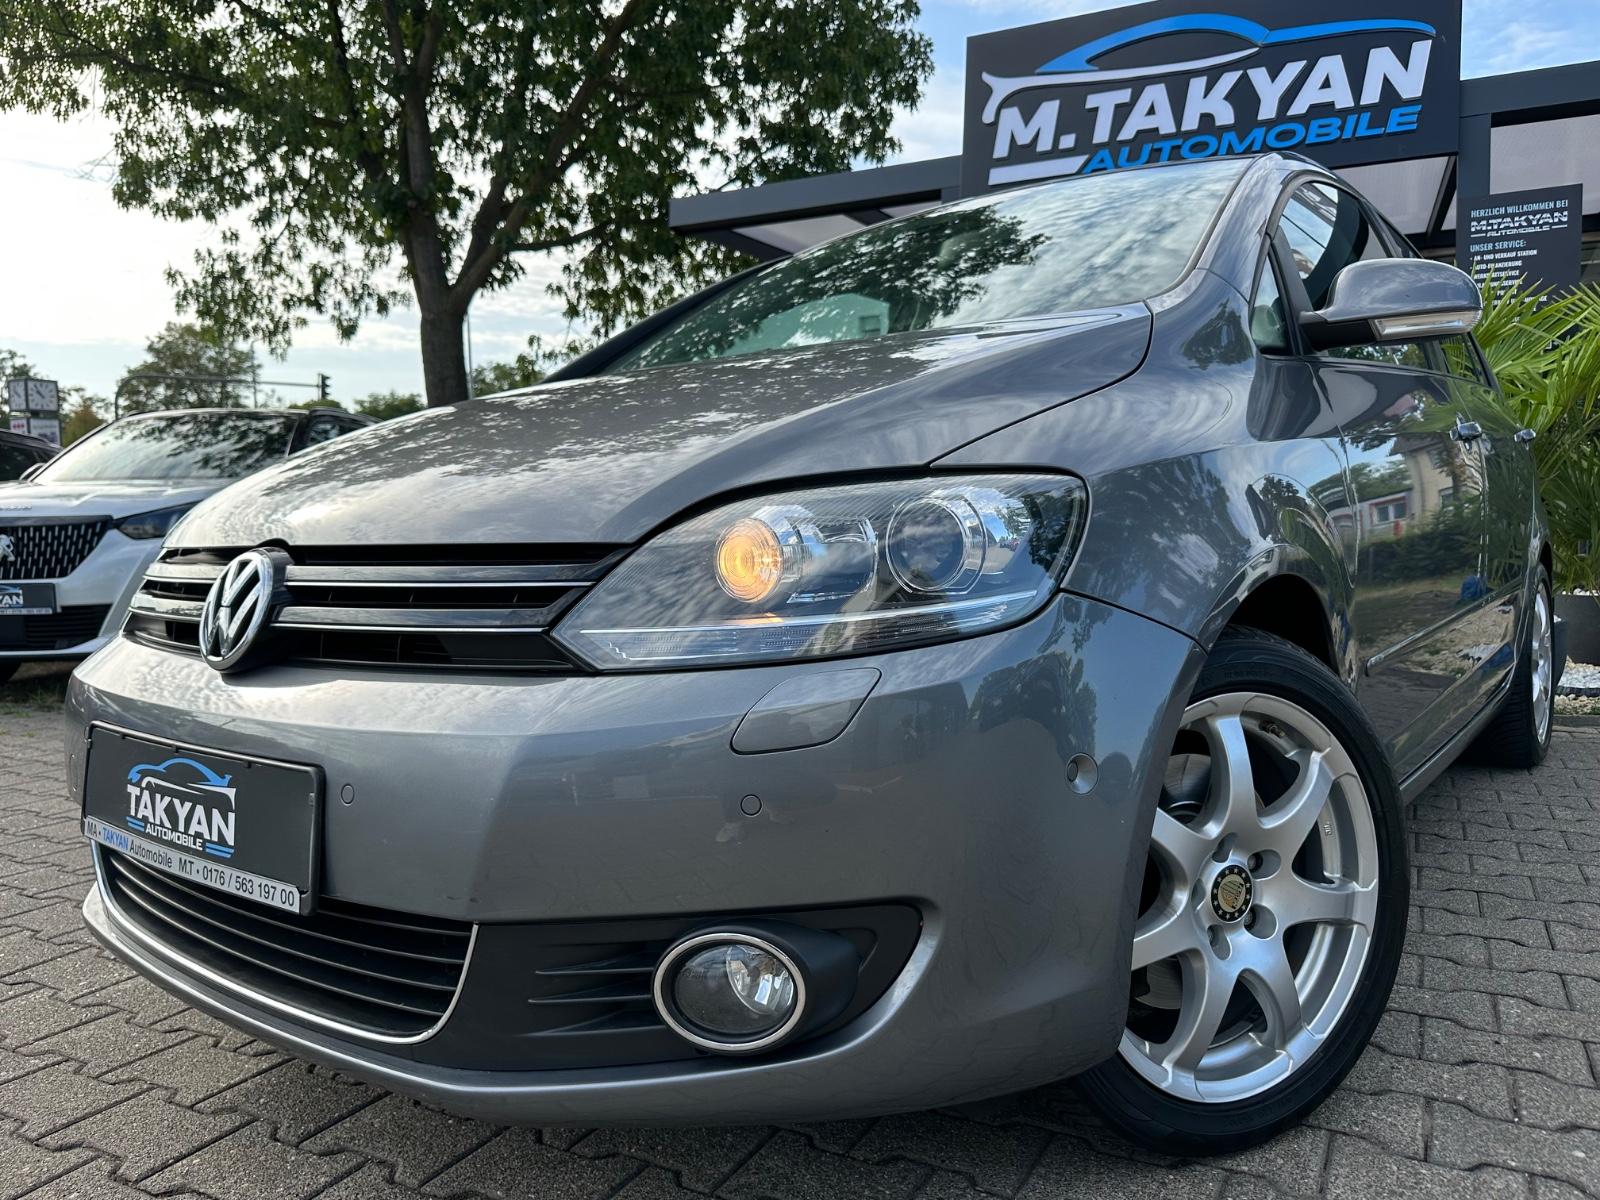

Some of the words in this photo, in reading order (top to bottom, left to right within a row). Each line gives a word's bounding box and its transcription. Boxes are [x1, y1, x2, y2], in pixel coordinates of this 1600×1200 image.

[1083, 104, 1423, 174] AUTOMOBILE
[1471, 206, 1505, 218] HERZLICH
[1506, 201, 1555, 214] WILLKOMMEN
[1556, 199, 1568, 208] BEI
[1470, 210, 1568, 232] M.TAKYAN
[1487, 225, 1550, 237] AUTOMOBILE
[1470, 242, 1493, 252] UNSER
[1494, 239, 1526, 250] SERVICE:
[1495, 251, 1516, 259] VERKAUF
[1517, 249, 1537, 257] STATION
[127, 784, 236, 847] TAKYAN
[145, 823, 204, 851] AUTOMOBILE
[87, 821, 98, 838] MA
[102, 827, 129, 851] TAKYAN
[130, 839, 173, 869] Automobile
[202, 865, 226, 886] 0176
[235, 875, 254, 895] 563
[258, 882, 277, 901] 197
[280, 888, 295, 907] 00
